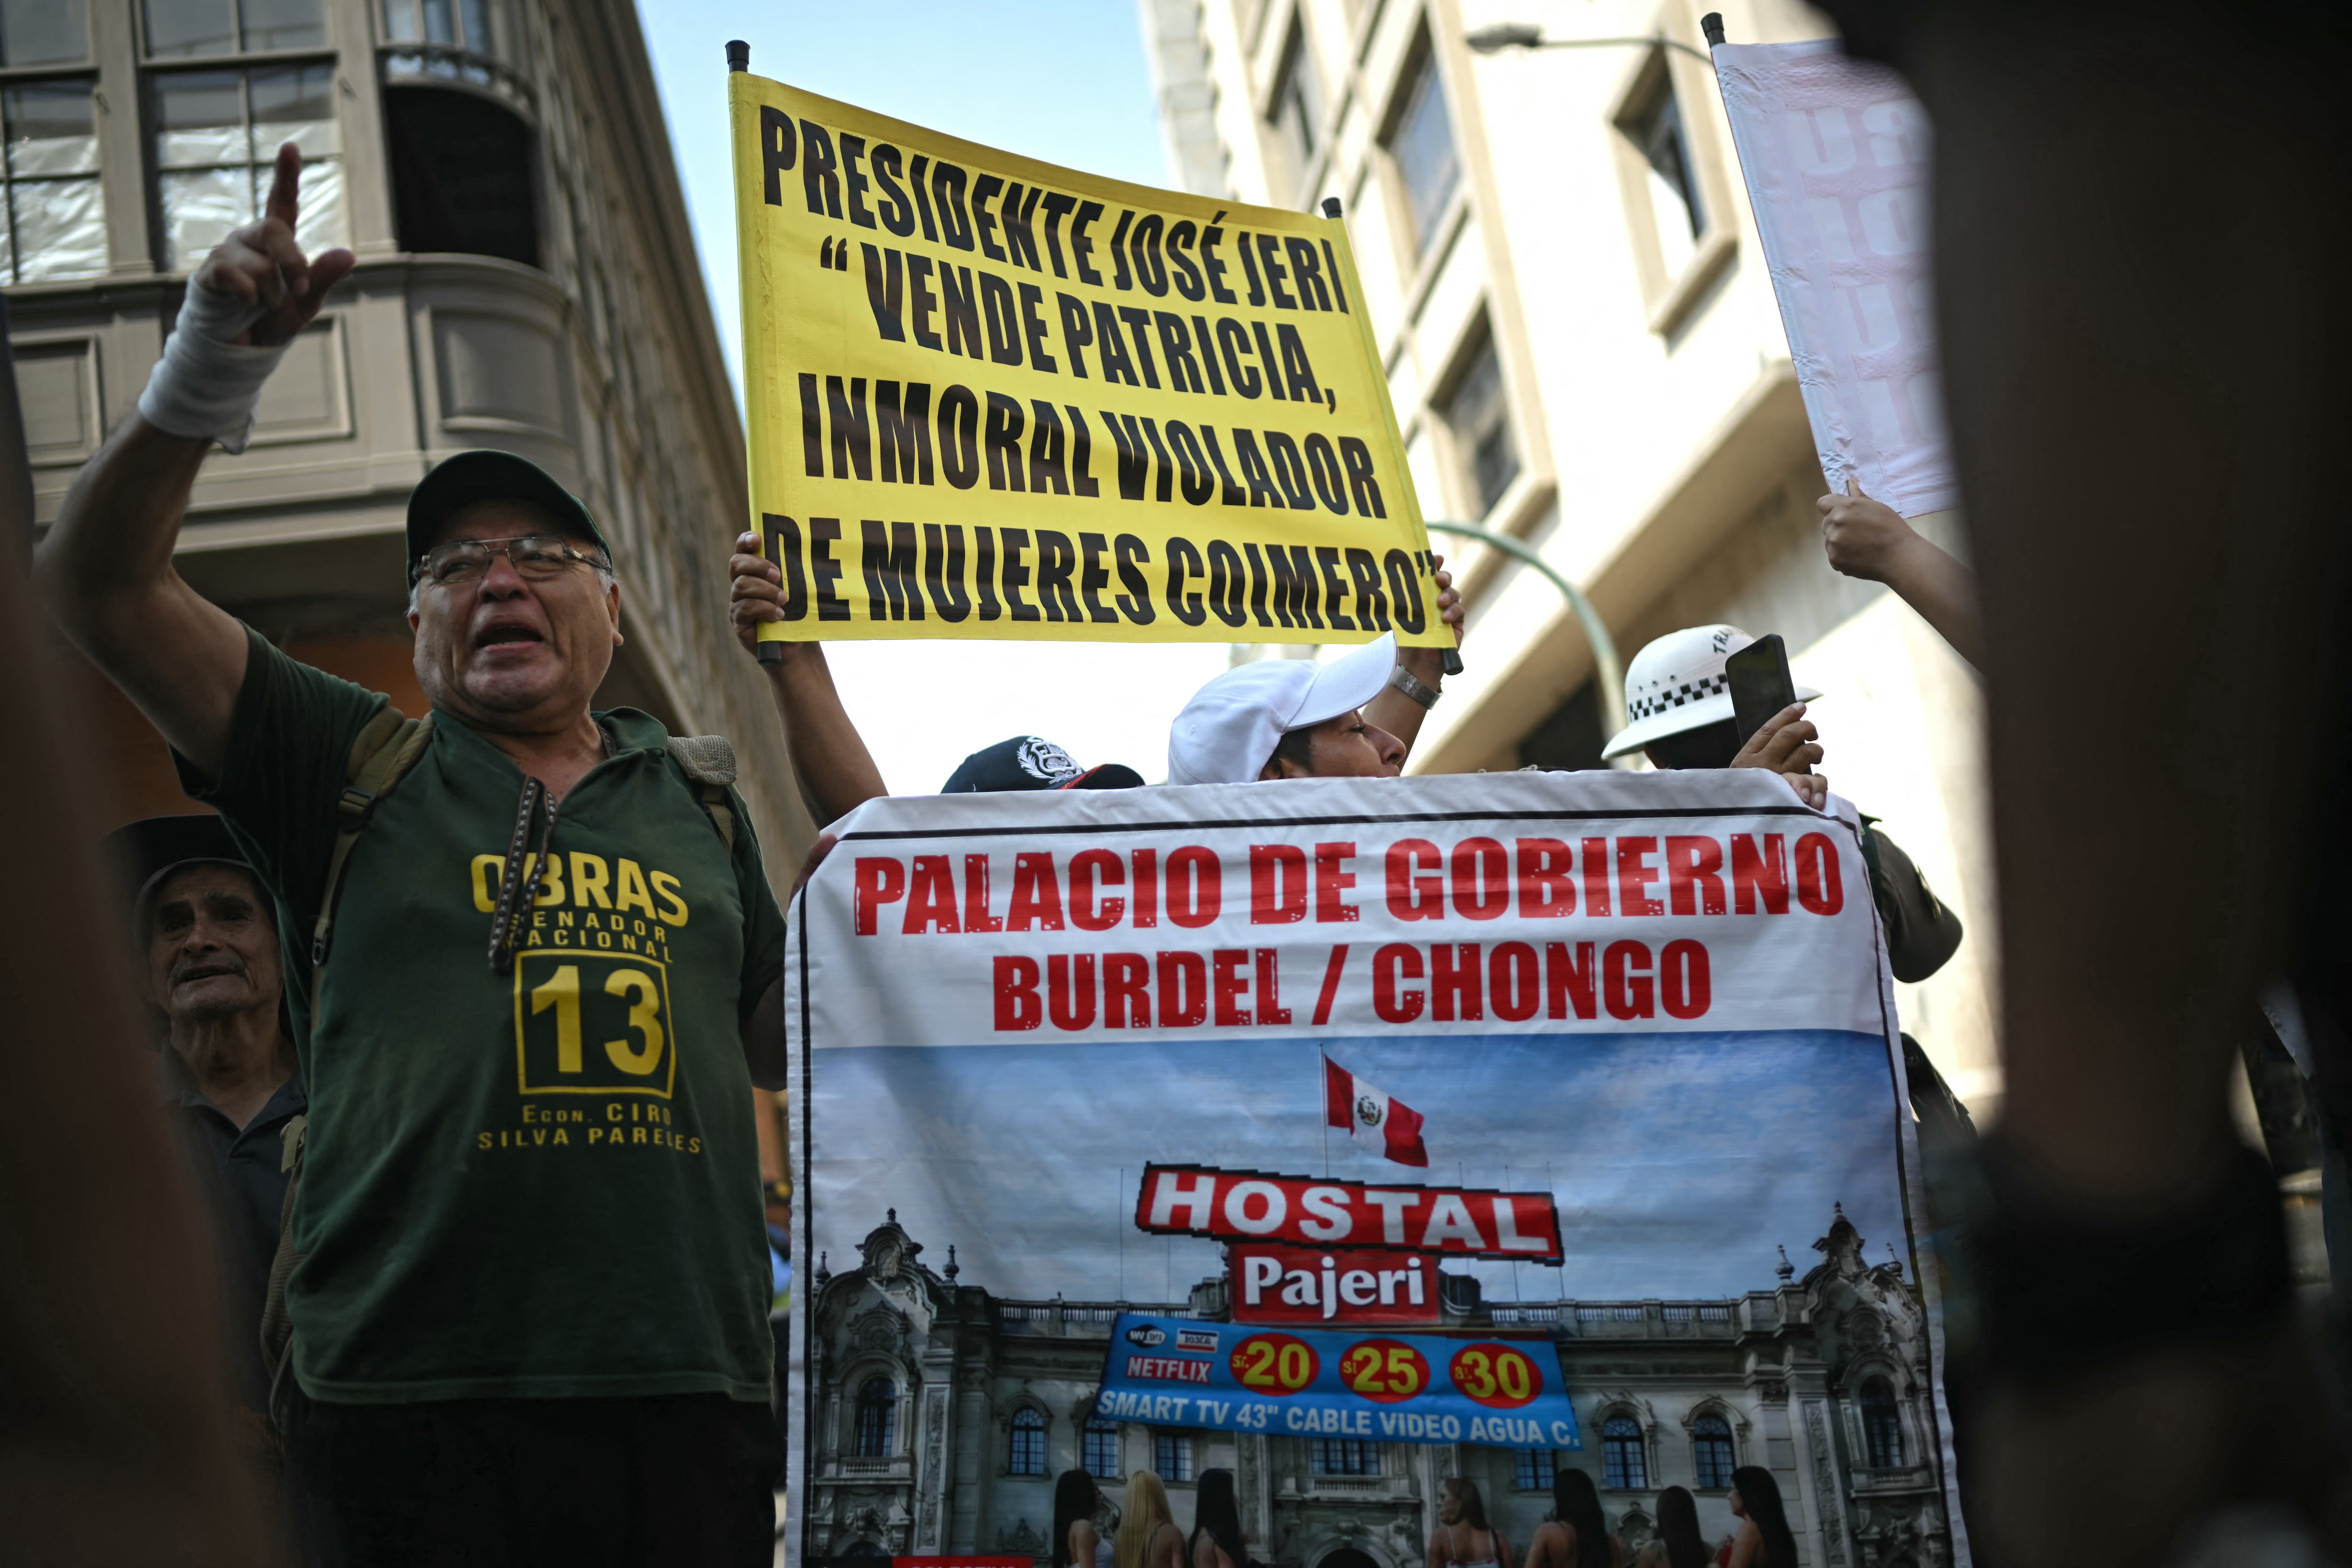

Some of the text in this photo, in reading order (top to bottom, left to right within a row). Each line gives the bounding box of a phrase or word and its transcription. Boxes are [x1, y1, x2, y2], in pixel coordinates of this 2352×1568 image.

[760, 104, 1349, 314] PRESIDENTE JOSÉ JERI
[1056, 291, 1336, 414] PATRICIA,
[798, 372, 1387, 519] INMORAL VIOLADOR
[762, 512, 851, 621] DE
[861, 520, 1156, 626] MUJERES
[471, 851, 689, 928] OBRAS
[854, 833, 1843, 935] PALACIO DE GOBIERNO
[531, 965, 664, 1076] 13
[993, 939, 1711, 1031] BURDEL / CHONGO
[478, 1129, 569, 1149] SILVA
[1150, 1172, 1549, 1251] HOSTAL
[1244, 1256, 1424, 1319] Pajeri
[1127, 1357, 1211, 1383] NETFLIX
[1098, 1390, 1190, 1422] SMART
[1196, 1400, 1230, 1424] TV
[1287, 1407, 1372, 1435] CABLE
[1379, 1412, 1461, 1440] VIDEO
[1470, 1416, 1545, 1443] AGUA
